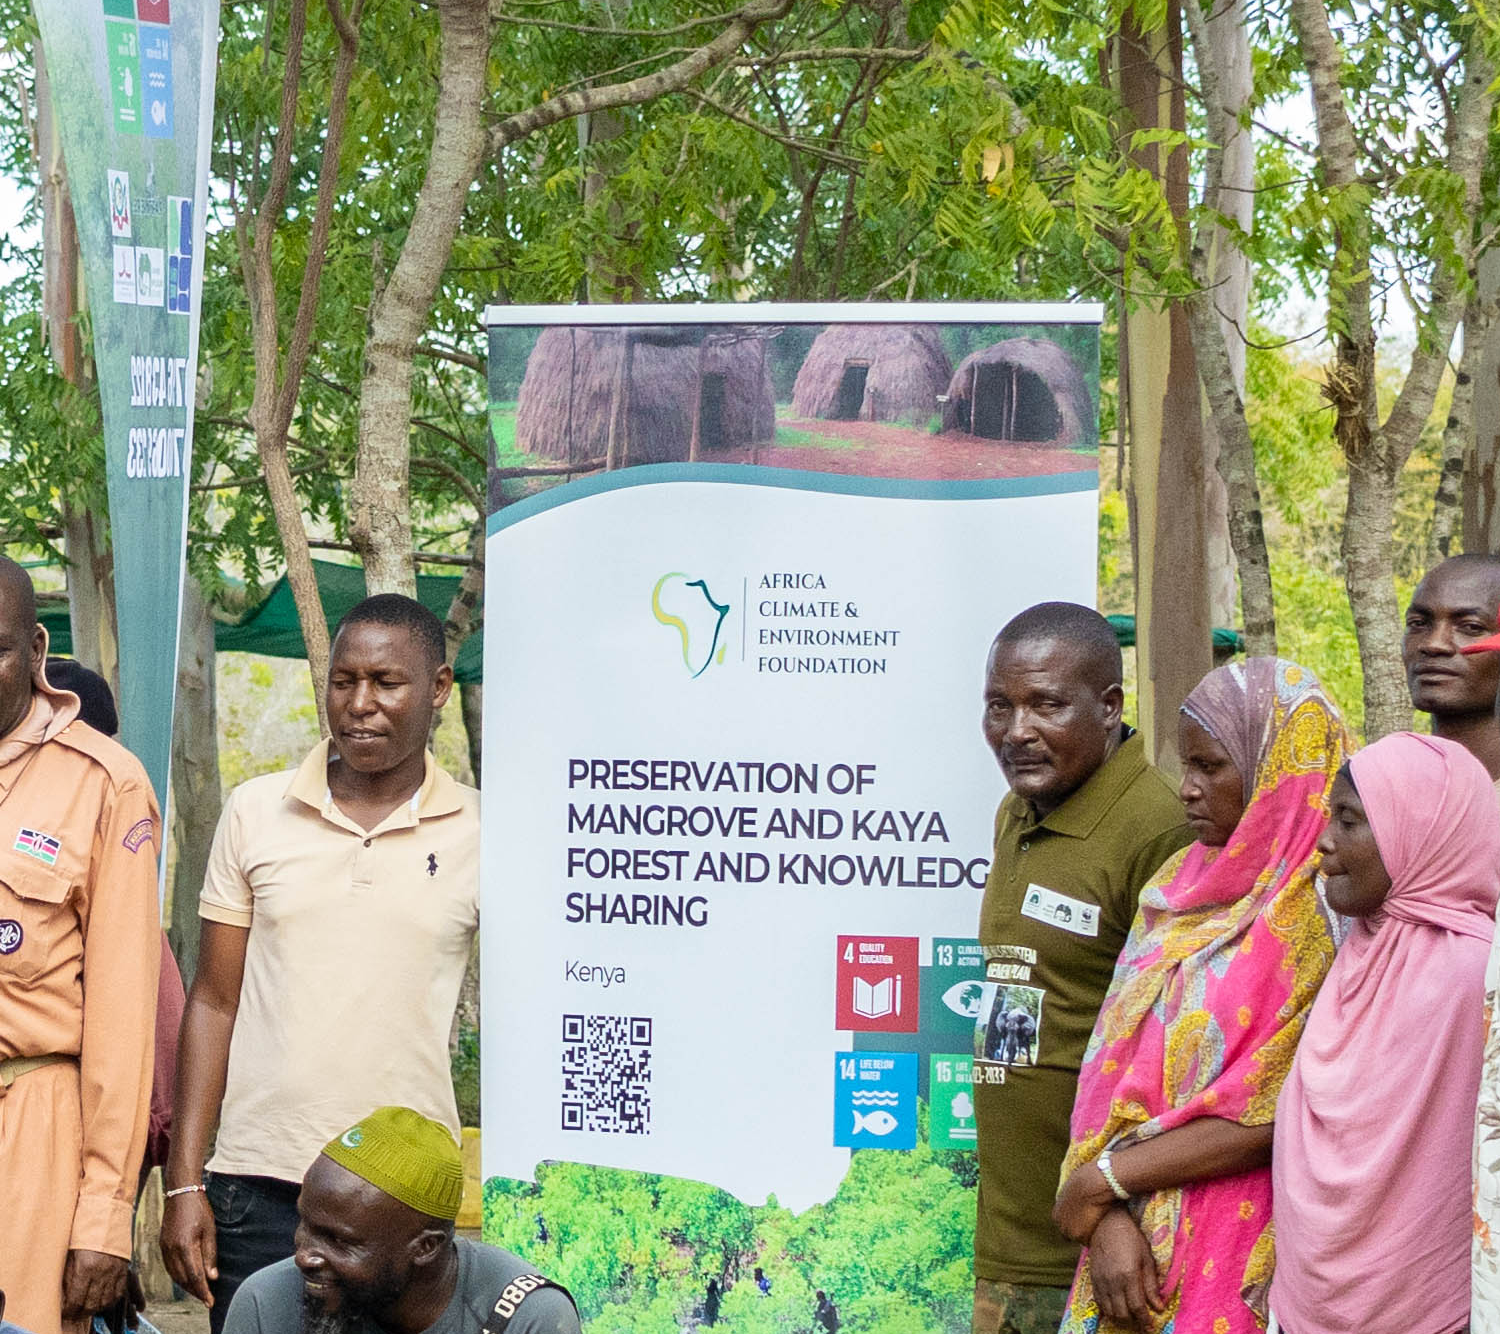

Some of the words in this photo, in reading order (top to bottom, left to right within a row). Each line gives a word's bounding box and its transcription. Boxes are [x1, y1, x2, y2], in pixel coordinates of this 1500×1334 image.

[759, 573, 827, 589] AFRICA
[759, 600, 840, 617] CLIMATE
[844, 602, 860, 618] &
[759, 629, 901, 647] ENVIRONMENT
[758, 657, 887, 674] FOUNDATION
[567, 759, 818, 794] PRESERVATION
[826, 763, 877, 795] OF
[567, 803, 758, 838] MANGROVE
[764, 807, 843, 840] AND
[851, 810, 950, 843] KAYA
[567, 847, 690, 881] FOREST
[694, 851, 770, 884] AND
[778, 853, 989, 889] KNOWLEDG
[565, 892, 709, 927] SHARING
[843, 942, 855, 964] 4
[936, 944, 953, 966] 13
[564, 960, 626, 988] Kenya
[839, 1058, 856, 1080] 14
[936, 1061, 952, 1083] 15
[494, 1273, 546, 1319] 1980
